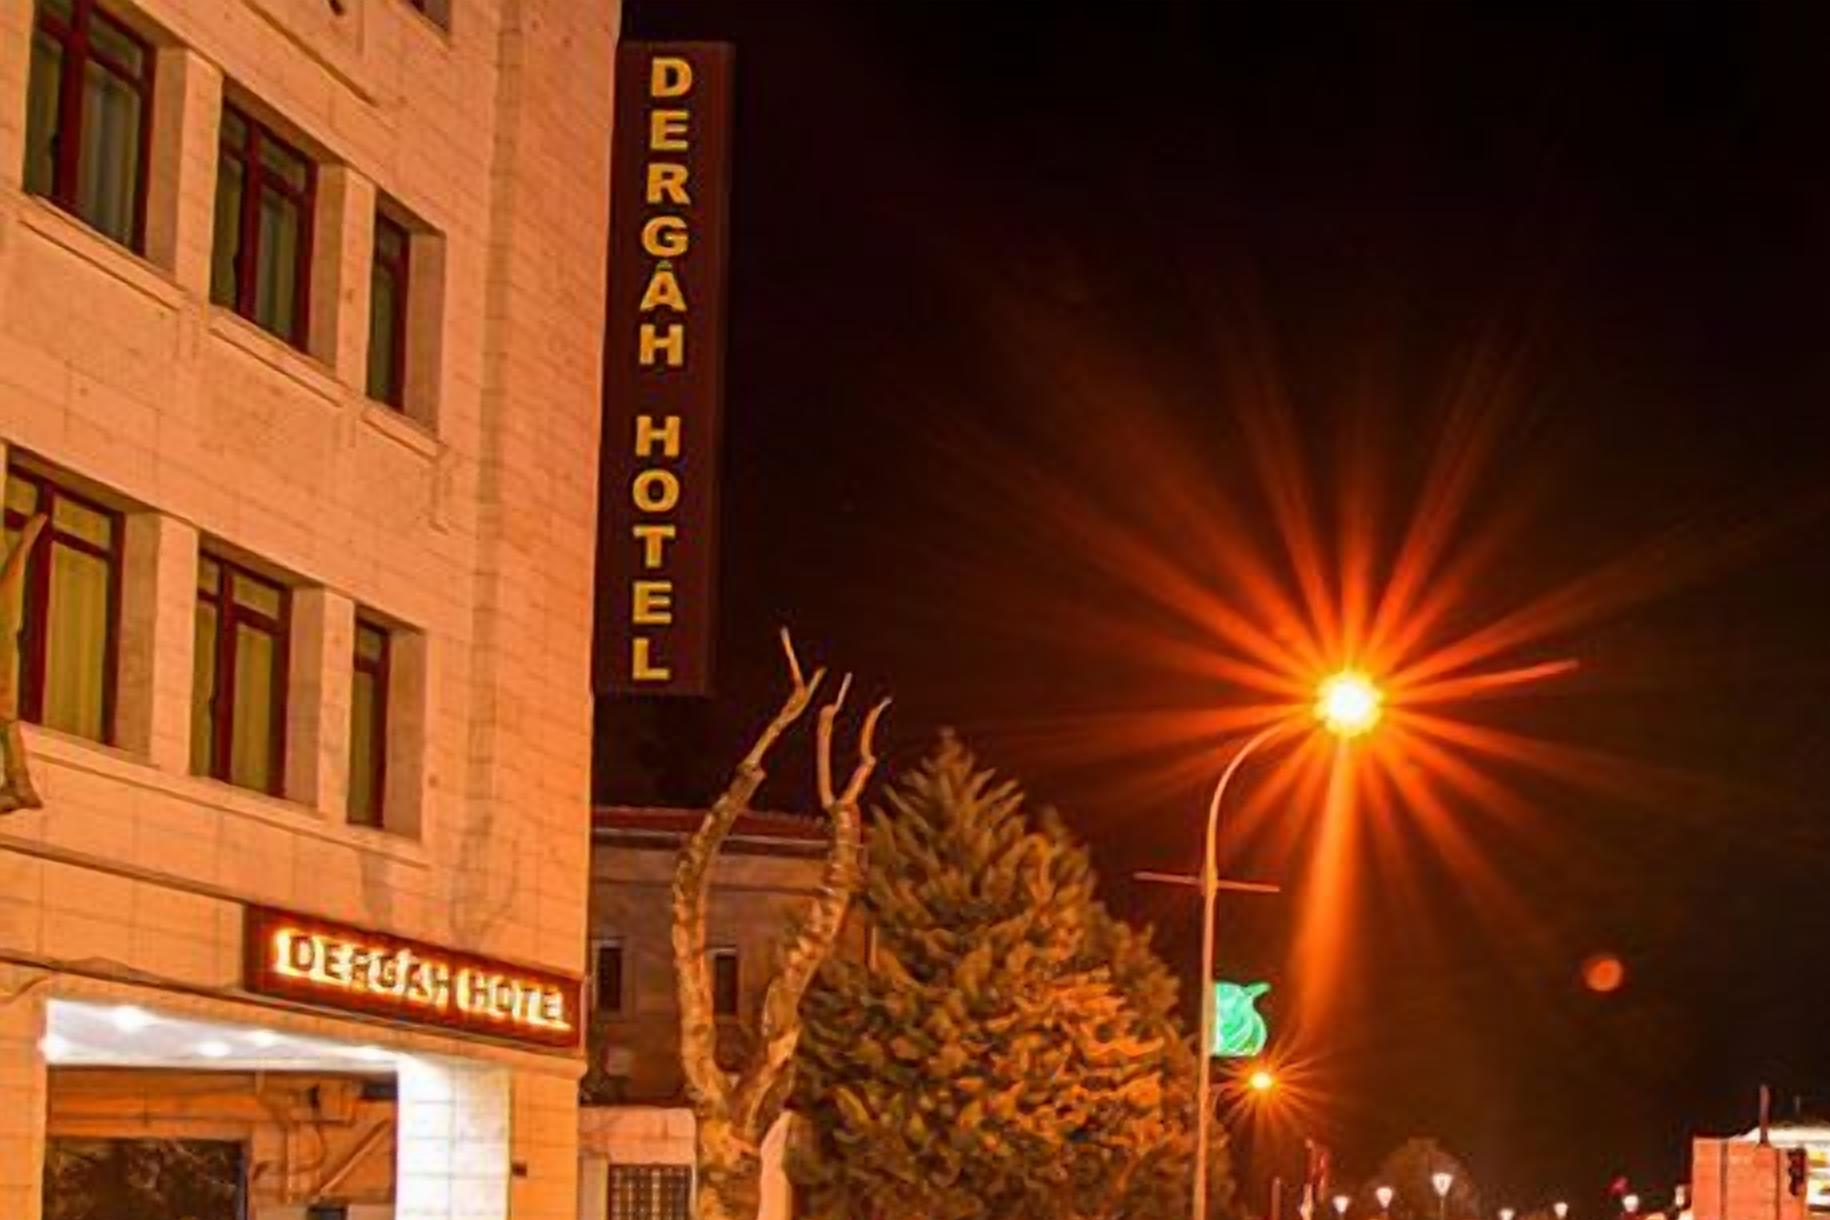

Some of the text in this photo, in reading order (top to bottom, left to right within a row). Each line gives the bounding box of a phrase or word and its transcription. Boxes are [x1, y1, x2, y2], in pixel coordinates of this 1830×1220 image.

[631, 56, 693, 681] DERGÂH HOTEL
[455, 966, 572, 1032] HOTEL
